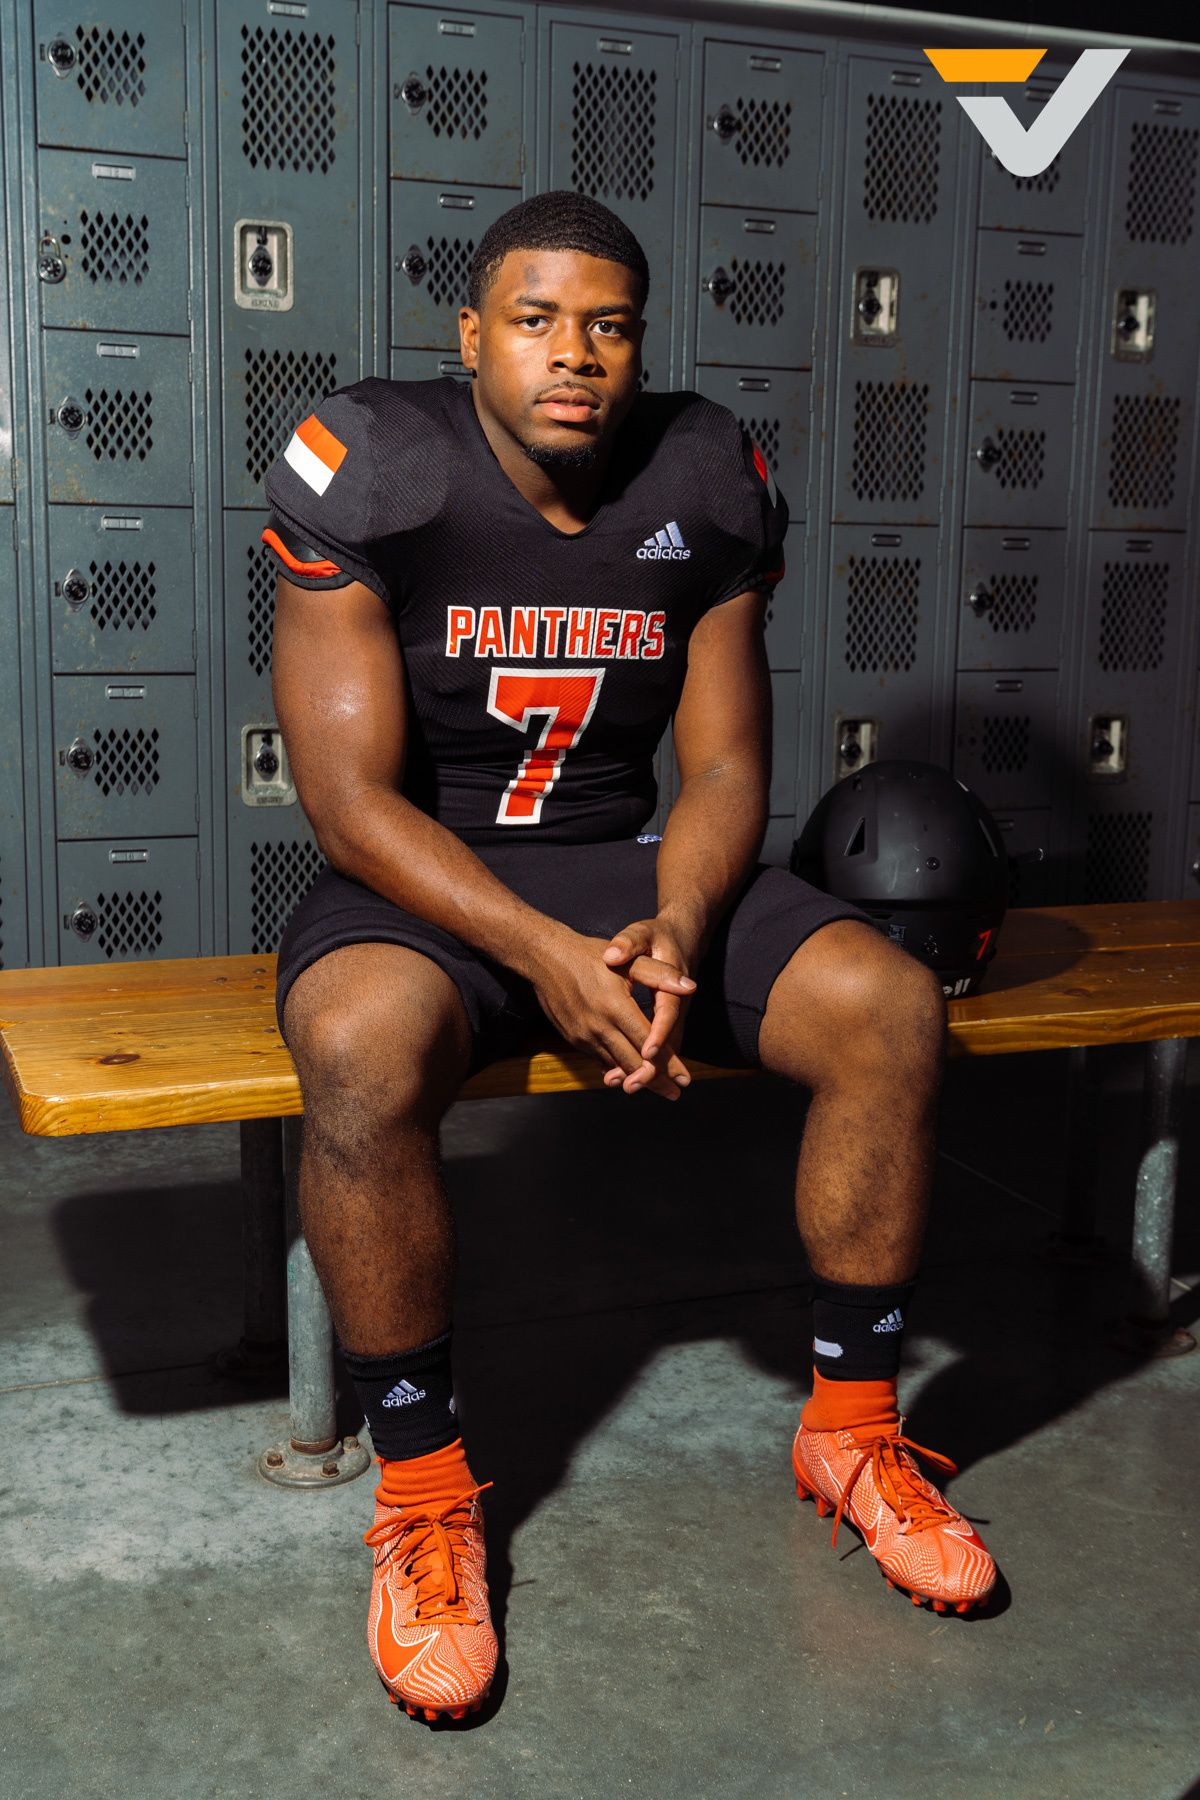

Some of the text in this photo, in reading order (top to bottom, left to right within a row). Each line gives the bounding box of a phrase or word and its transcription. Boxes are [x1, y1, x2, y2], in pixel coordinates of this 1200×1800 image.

[636, 545, 691, 560] adidas
[445, 605, 666, 660] PANTHERS
[486, 667, 606, 825] 7
[382, 1389, 426, 1408] adidas
